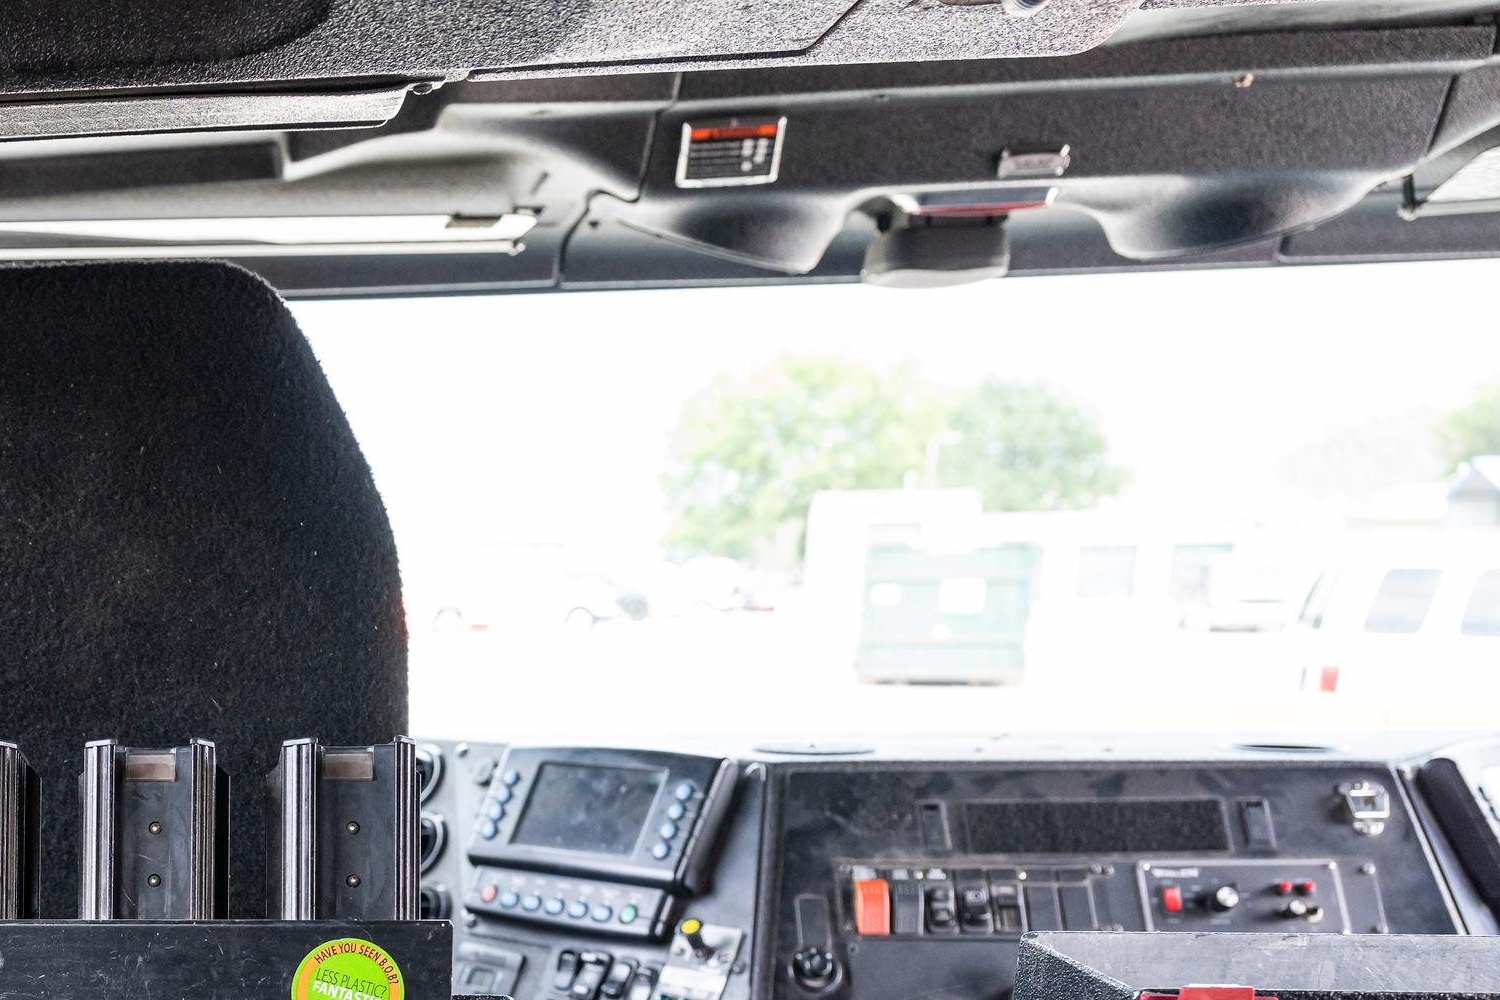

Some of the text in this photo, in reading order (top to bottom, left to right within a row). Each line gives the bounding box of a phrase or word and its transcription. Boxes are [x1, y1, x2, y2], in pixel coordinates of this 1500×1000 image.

[314, 945, 337, 964] HAVE
[338, 943, 356, 953] YOU
[359, 945, 381, 961] SEEN
[316, 968, 387, 999] LESS PLASTIC?
